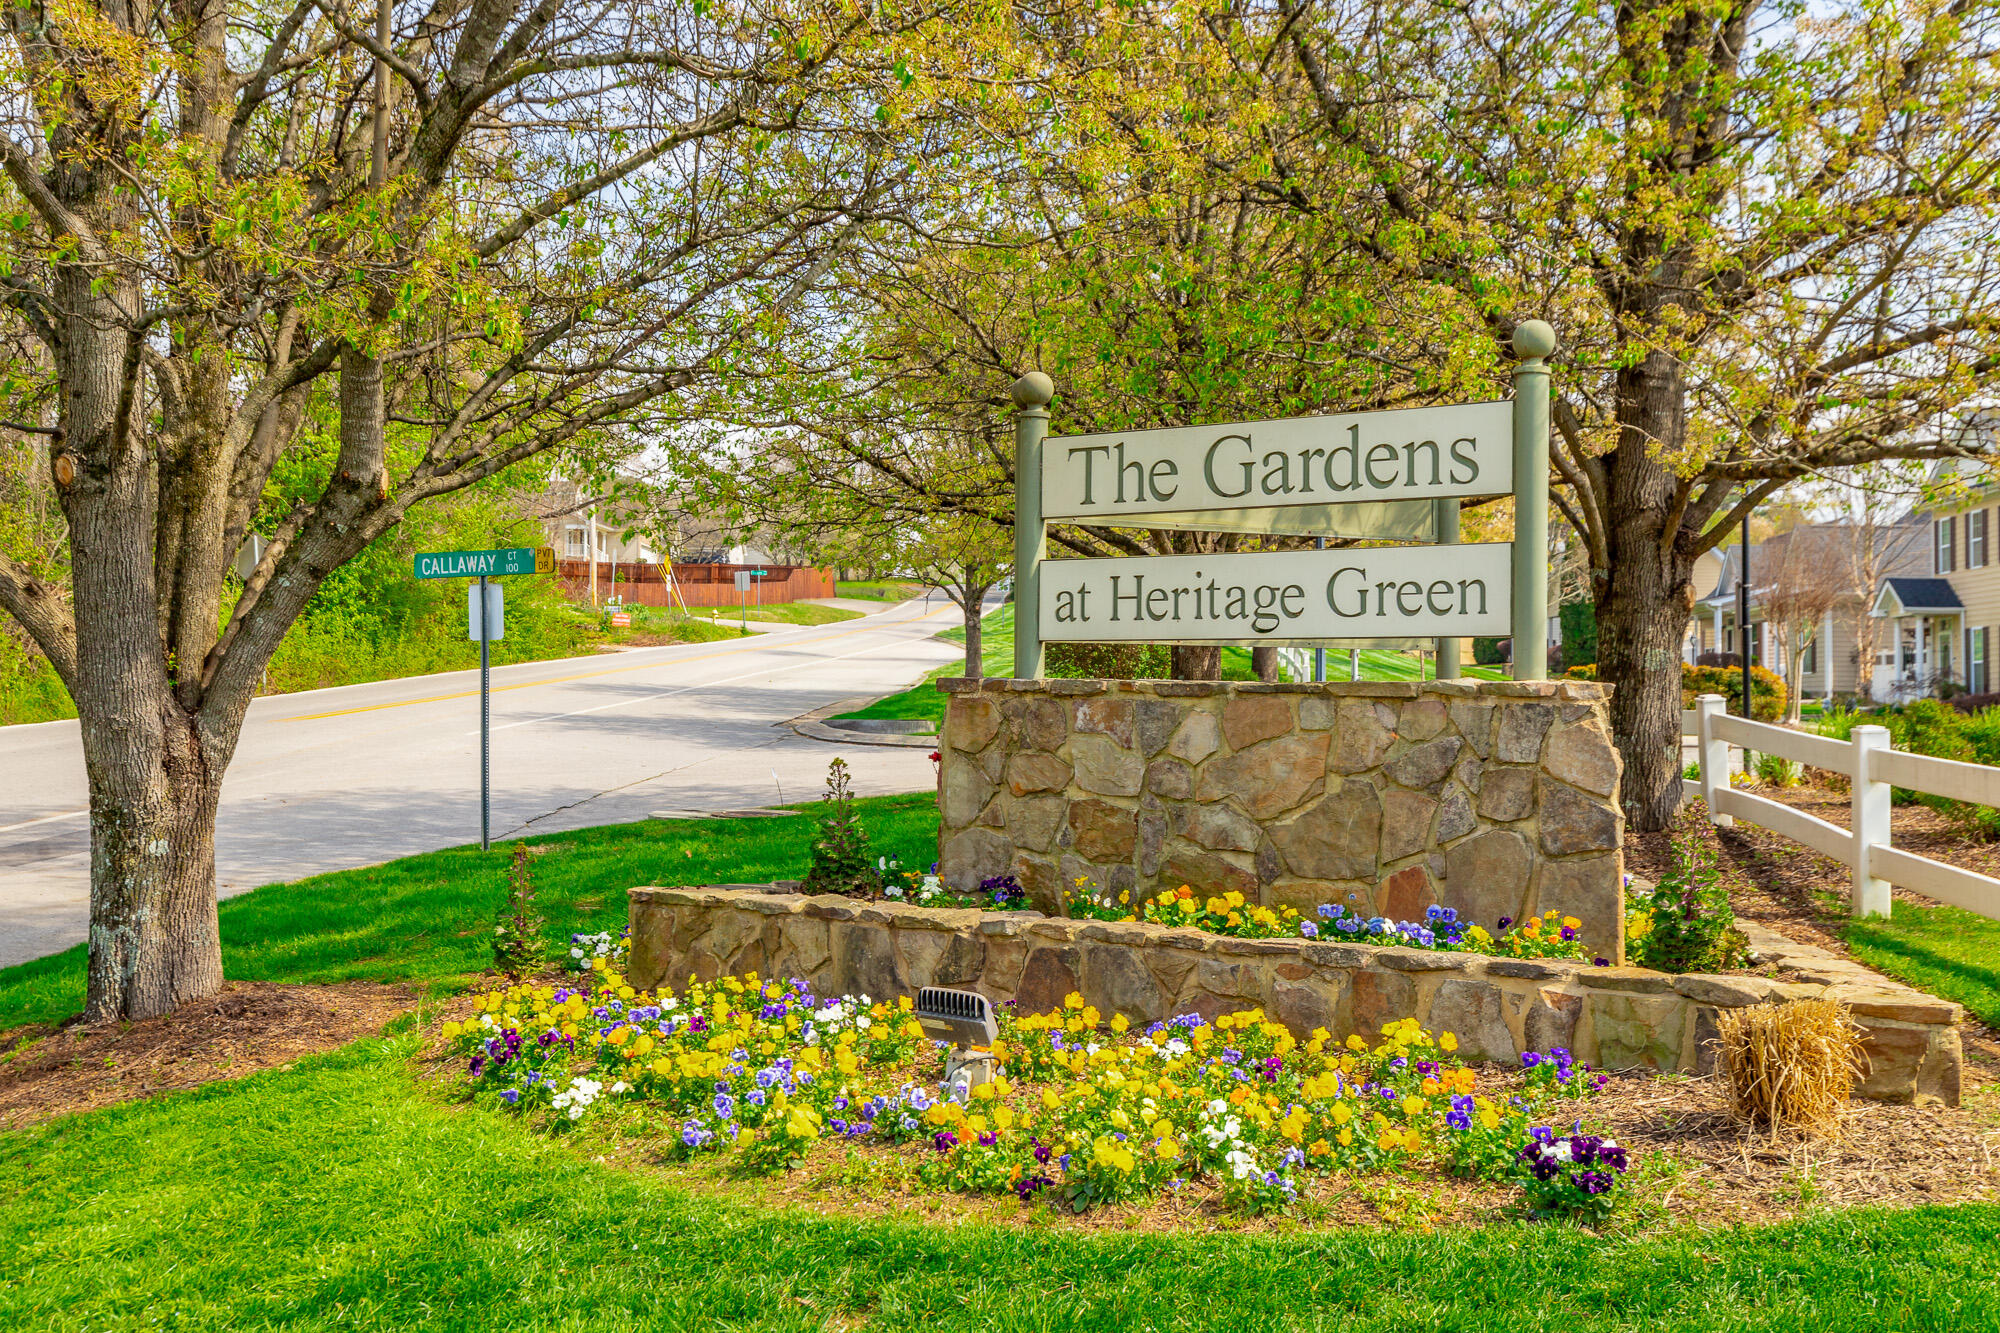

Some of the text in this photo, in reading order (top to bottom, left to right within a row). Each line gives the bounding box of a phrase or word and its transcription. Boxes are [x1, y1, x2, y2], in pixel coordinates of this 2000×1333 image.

[1068, 423, 1480, 505] The Gardens
[536, 548, 551, 557] PVT
[421, 551, 517, 575] CALLAWAY CT
[505, 563, 519, 573] 100
[538, 561, 549, 570] DR
[1055, 567, 1488, 634] at Heritage Green
